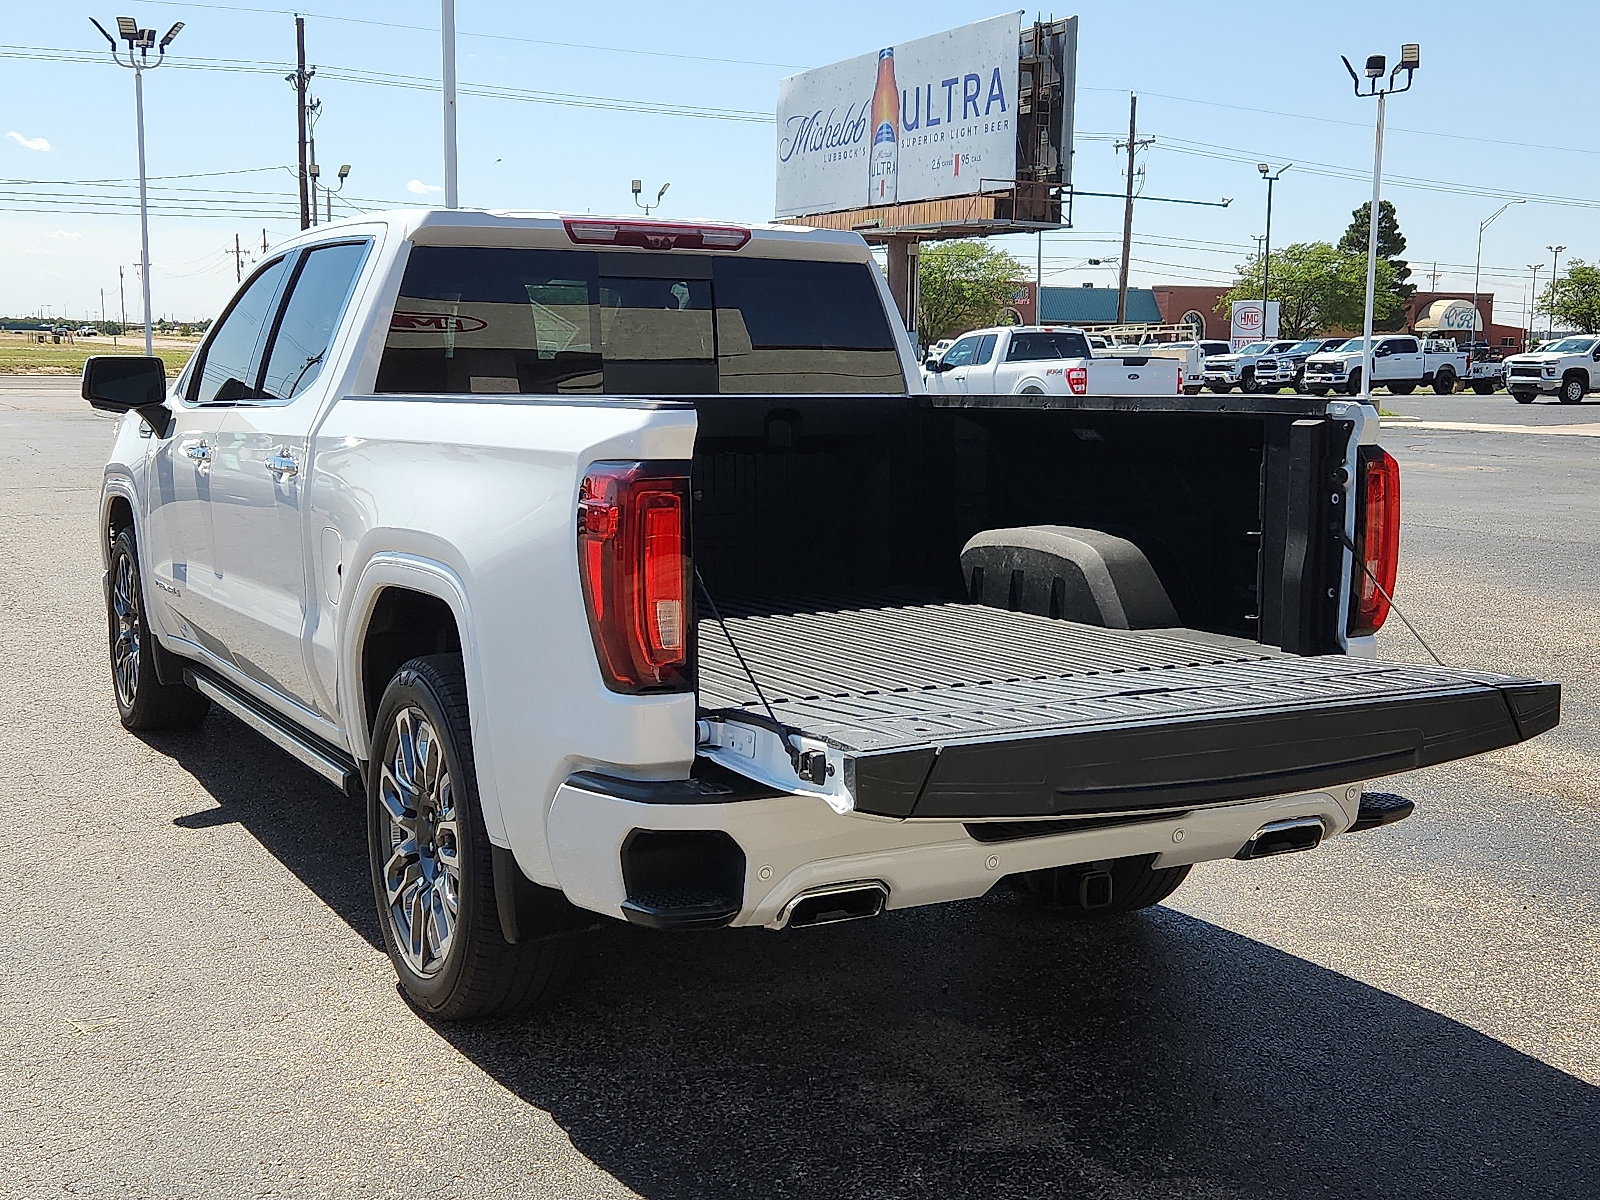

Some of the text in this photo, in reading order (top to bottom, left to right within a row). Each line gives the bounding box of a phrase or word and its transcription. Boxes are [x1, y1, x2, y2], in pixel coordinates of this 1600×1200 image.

[902, 67, 1006, 132] ULTRA
[779, 99, 871, 162] Michelob
[901, 131, 945, 149] SUPERIOR
[950, 125, 978, 140] LIGHT
[984, 119, 1009, 134] BEER
[823, 147, 866, 163] LUBBOCK'S
[960, 153, 970, 166] 95
[1240, 311, 1259, 325] HMC
